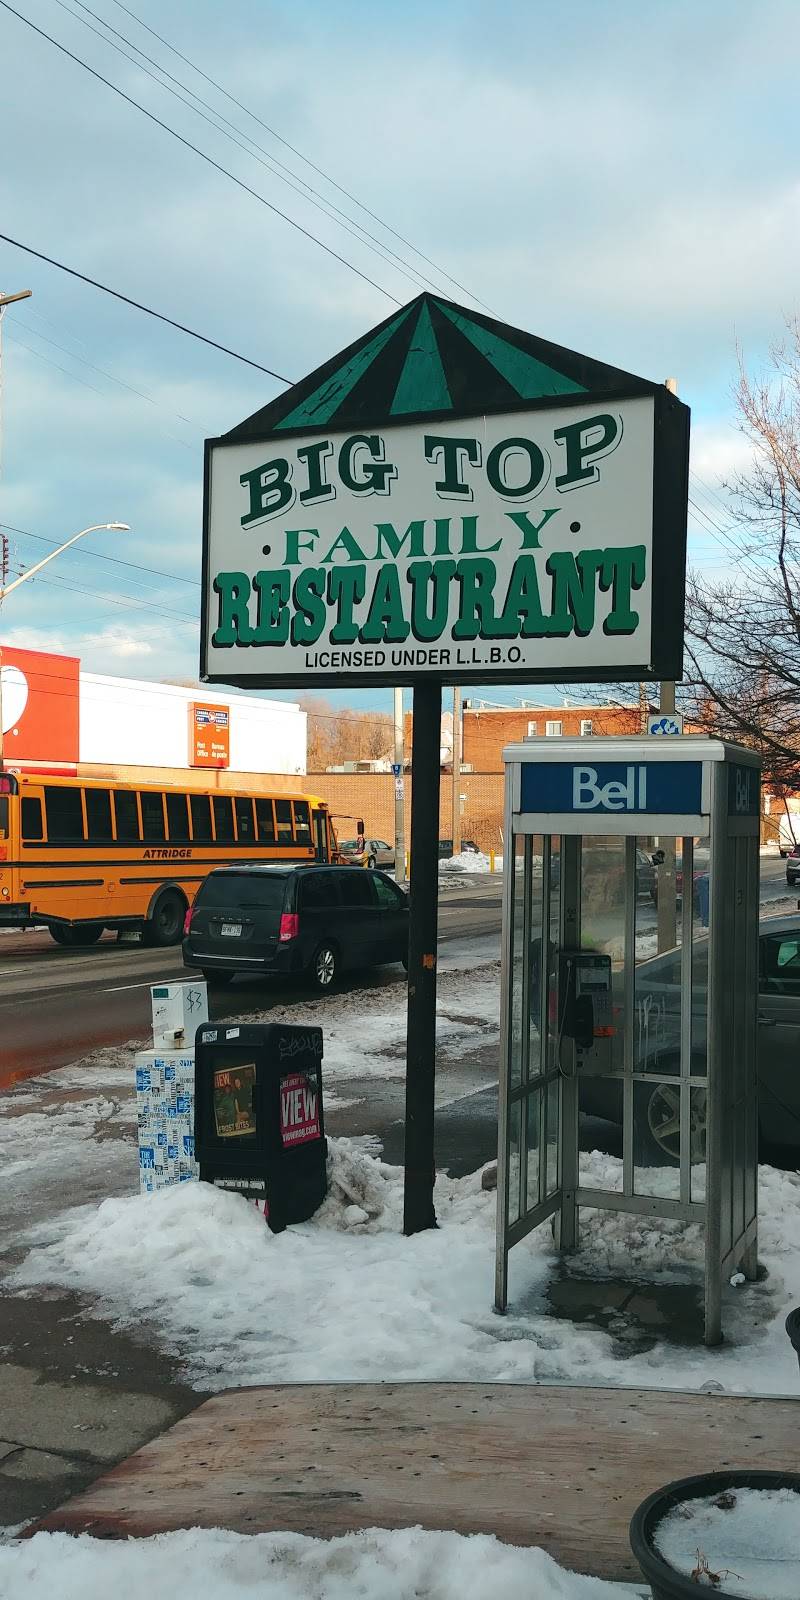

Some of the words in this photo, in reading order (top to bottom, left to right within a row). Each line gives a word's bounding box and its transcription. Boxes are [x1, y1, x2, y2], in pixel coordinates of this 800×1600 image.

[240, 434, 398, 530] BIG
[424, 414, 624, 504] TOP
[282, 508, 562, 566] FAMILY
[212, 544, 646, 649] RESTAURANT
[305, 650, 386, 668] LICENSED
[391, 648, 451, 666] UNDER
[456, 646, 526, 665] L.L.B.O.
[572, 766, 647, 810] Bell
[736, 768, 750, 811] Bell
[143, 848, 193, 859] ATTRIDGE
[186, 989, 202, 1013] $3
[281, 1087, 317, 1128] VIEW
